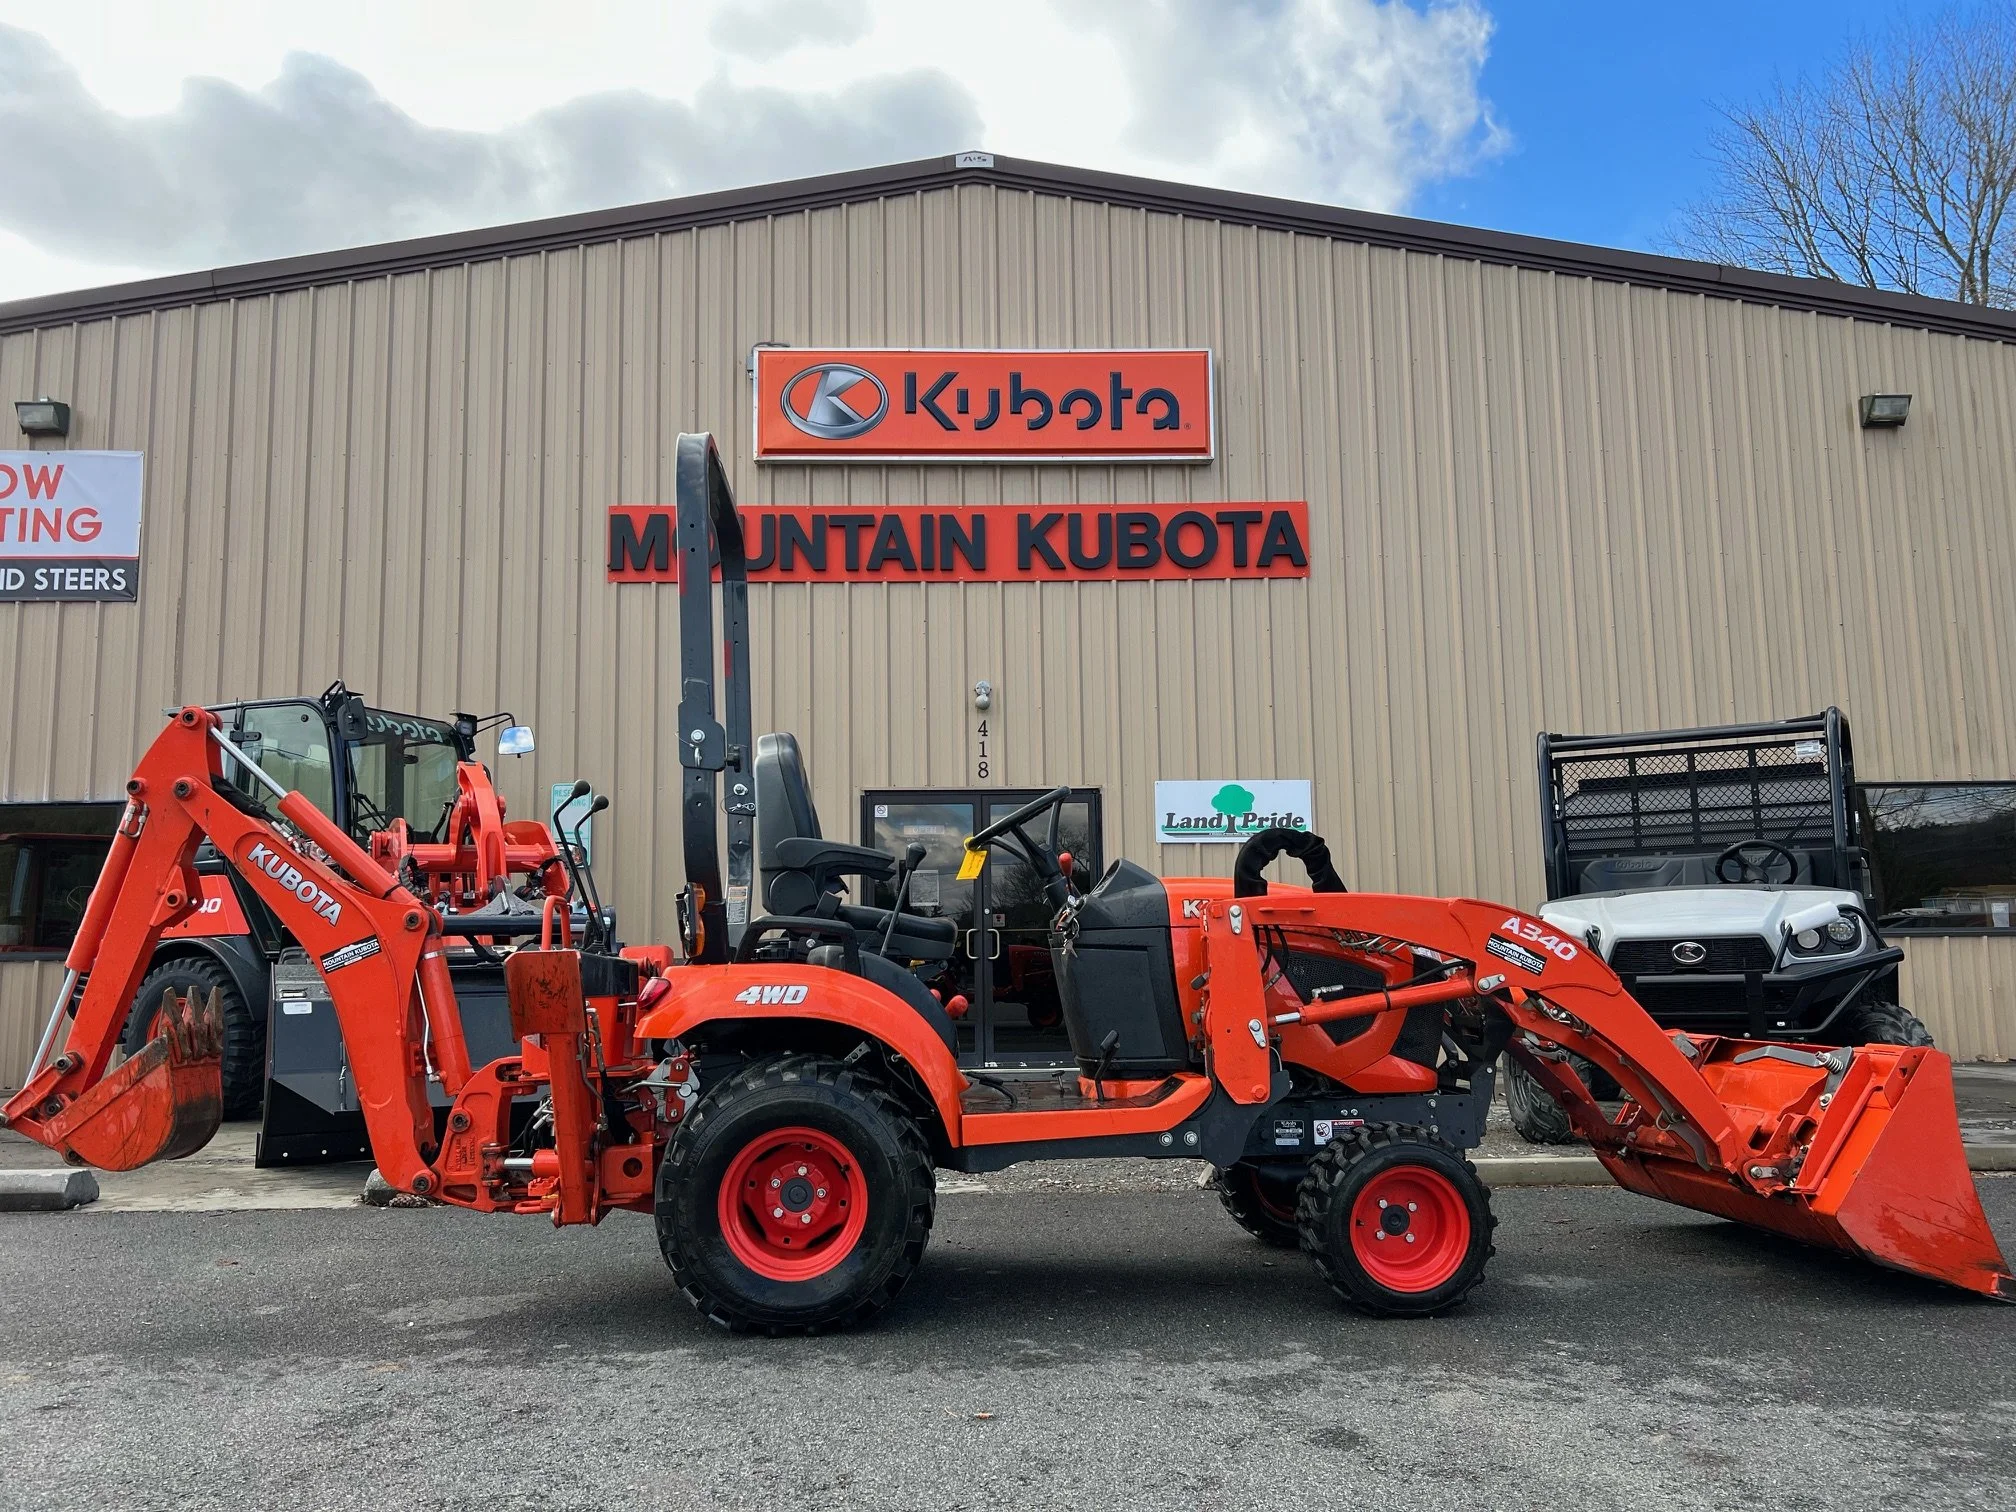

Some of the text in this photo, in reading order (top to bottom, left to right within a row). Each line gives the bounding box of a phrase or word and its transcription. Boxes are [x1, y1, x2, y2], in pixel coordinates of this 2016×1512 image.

[904, 371, 1180, 431] Kubota
[1016, 510, 1308, 570] KUBOTA
[34, 568, 127, 591] STEERS
[366, 714, 444, 743] ubota
[977, 719, 989, 779] 418
[1164, 812, 1305, 829] Land Pride
[247, 842, 343, 927] KUBOTA
[1500, 916, 1578, 961] A340
[323, 951, 355, 968] MOUNTAIN
[354, 941, 380, 955] KUBOTA
[1487, 940, 1520, 958] MOUNTAIN
[1520, 953, 1543, 970] KUBOTA
[734, 985, 809, 1005] 4WD
